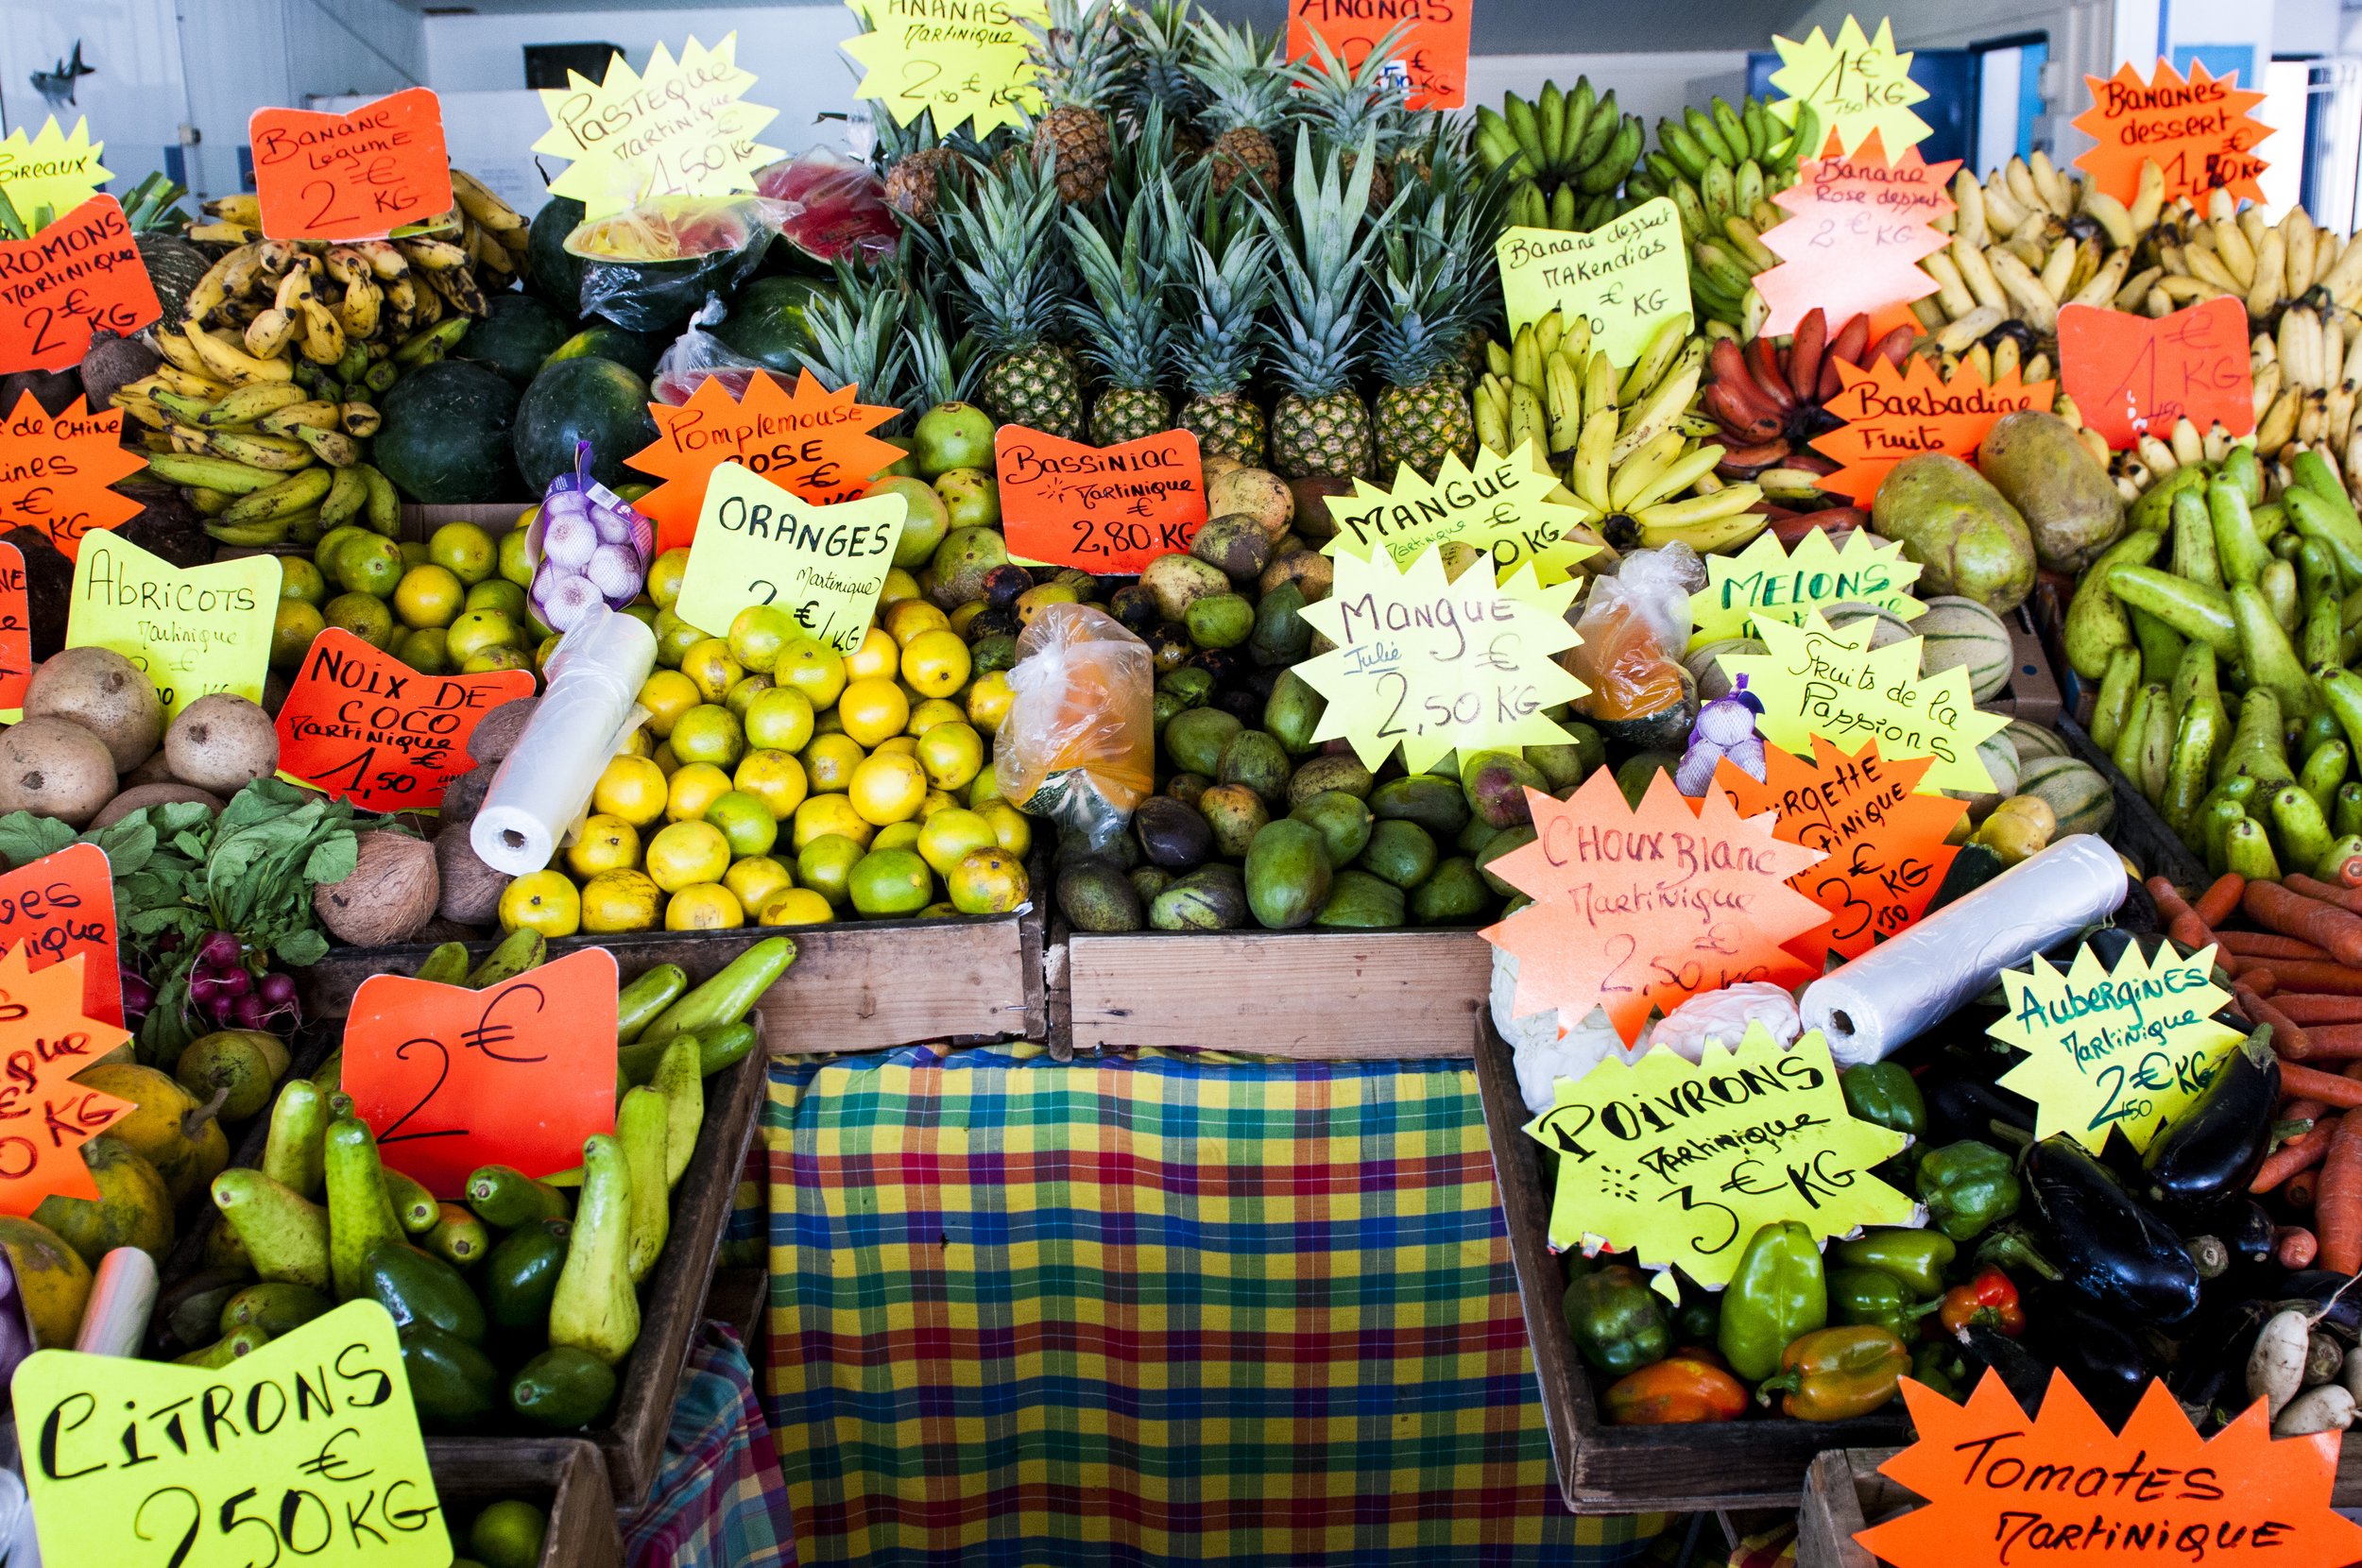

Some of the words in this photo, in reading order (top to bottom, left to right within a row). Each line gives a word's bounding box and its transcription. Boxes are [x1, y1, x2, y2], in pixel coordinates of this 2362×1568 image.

[1849, 49, 1882, 78] €
[989, 83, 1027, 109] KG
[1420, 75, 1455, 95] KG
[1864, 82, 1906, 108] KG
[707, 111, 743, 140] €
[2221, 128, 2253, 155] €
[350, 157, 406, 185] €
[300, 180, 360, 230] 2
[374, 186, 425, 213] KG
[1808, 219, 1836, 248] 2
[1844, 211, 1872, 235] €
[1876, 225, 1914, 246] KG
[1599, 281, 1624, 306] €
[1633, 288, 1669, 317] KG
[24, 306, 67, 356] 2
[58, 288, 96, 319] €
[87, 302, 138, 332] KG
[2164, 311, 2221, 349] €
[2182, 355, 2242, 397] KG
[796, 462, 841, 488] €
[12, 486, 54, 515] €
[49, 512, 104, 543] KG
[1126, 497, 1154, 518] €
[1344, 463, 1520, 546] MANGUE
[1483, 502, 1521, 530] €
[719, 495, 891, 558] ORANGES
[1071, 520, 1153, 556] 2,80
[1159, 520, 1196, 551] KG
[1522, 520, 1561, 554] KG
[1721, 564, 1891, 611] MELONS
[168, 649, 199, 673] €
[1474, 632, 1521, 672] €
[418, 682, 504, 710] DE
[1376, 671, 1481, 740] 2,50
[1497, 684, 1542, 724] KG
[1886, 679, 1918, 708] de
[1928, 690, 1959, 731] la
[337, 700, 461, 735] COCO
[308, 746, 417, 799] 1,50
[410, 751, 448, 770] €
[1847, 843, 1886, 878] €
[1879, 858, 1935, 899] KG
[1600, 932, 1702, 997] 2,50
[1694, 921, 1742, 955] €
[375, 1037, 470, 1145] 2
[460, 982, 548, 1064] €
[2128, 1051, 2174, 1090] €
[2174, 1050, 2217, 1096] KG
[44, 1092, 121, 1148] KG
[1657, 1185, 1740, 1255] 3
[1720, 1159, 1789, 1197] €
[1786, 1149, 1857, 1210] KG
[298, 1427, 375, 1481] €
[347, 1479, 439, 1550] KG
